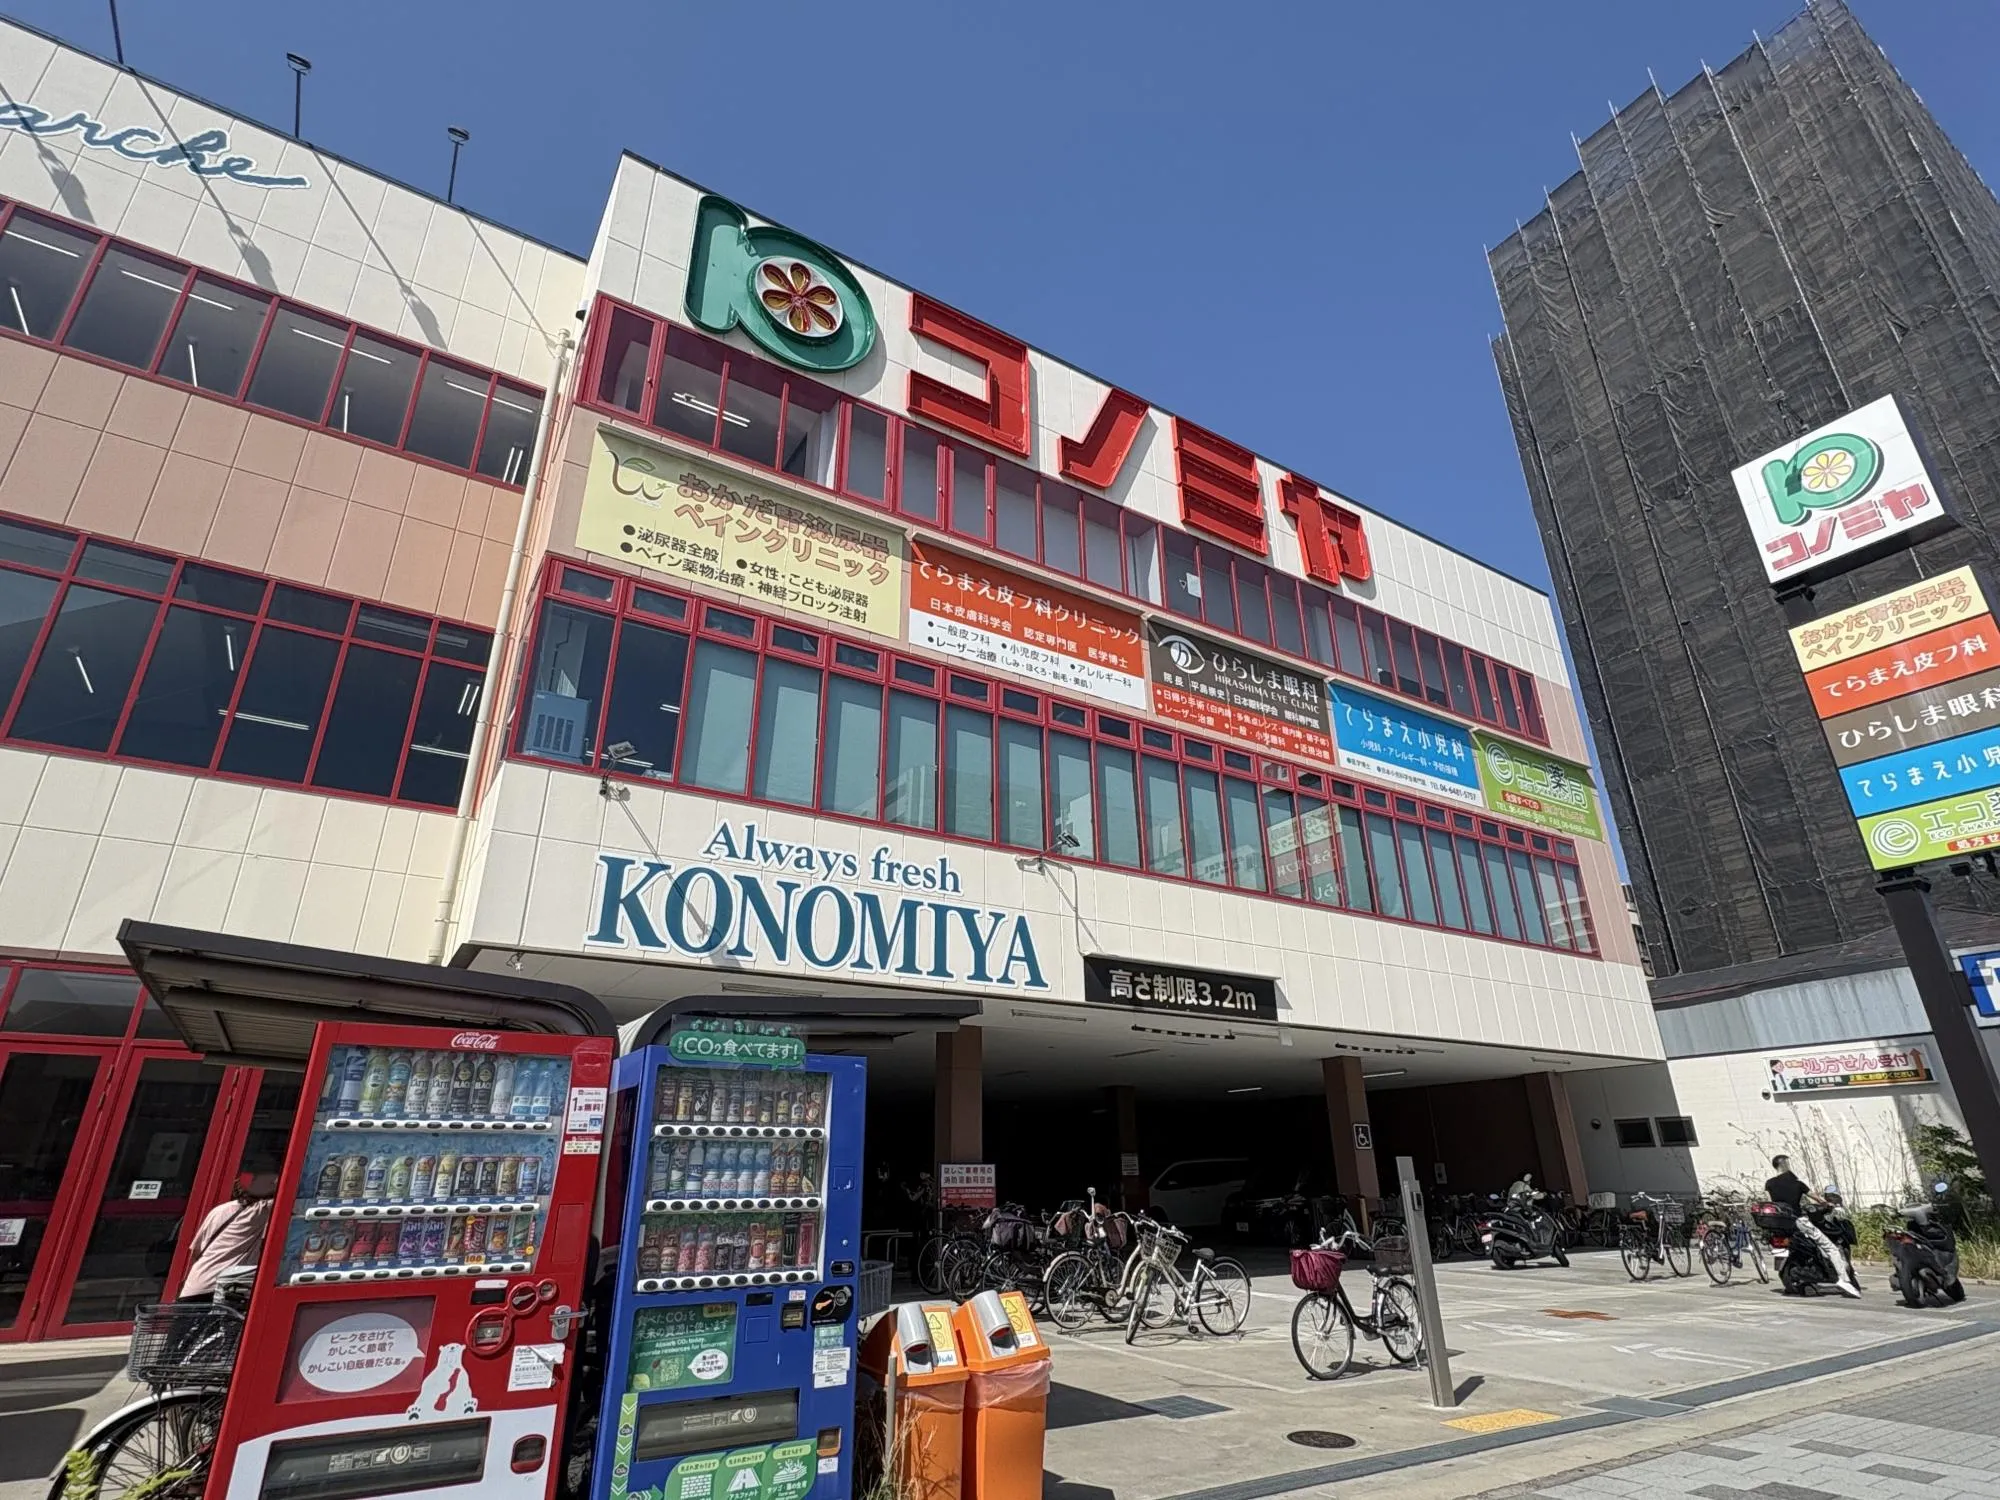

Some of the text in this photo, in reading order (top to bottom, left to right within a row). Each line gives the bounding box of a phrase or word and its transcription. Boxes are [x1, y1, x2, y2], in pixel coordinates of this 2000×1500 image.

[908, 290, 1374, 586] コノミヤ
[674, 501, 890, 586] ペインクリニック
[677, 472, 890, 563] おかだ腎泌尿器
[1765, 483, 1930, 571] コノミヤ
[635, 547, 867, 624] ペイン薬物治療・神経ブロック注射
[637, 526, 869, 608] 泌尿器全般 女性・こども泌尿器
[915, 558, 1142, 645] てらまえ皮フ科クリニック
[930, 598, 1129, 668] 日本皮膚科学会 認定専門医 医学博士
[1800, 576, 1967, 647] おかだ腎泌尿器
[1807, 595, 1972, 659] ペインクリニック
[937, 625, 1132, 689] 一般皮フ科 小児皮フ科 アレルギー科
[1212, 652, 1319, 701] ひらしま眼科
[1822, 634, 1988, 697] てらまえ皮フ科
[1214, 674, 1320, 715] HIRASHIMA EYE CLINIC
[1340, 704, 1465, 761] てらまえ小児科
[1513, 756, 1588, 809] エコ薬局
[704, 822, 962, 894] Always fresh
[586, 855, 1050, 989] KONOMIYA
[1109, 968, 1257, 1012] 高さ制限3.2m
[1801, 1052, 1908, 1076] 処方せん受付
